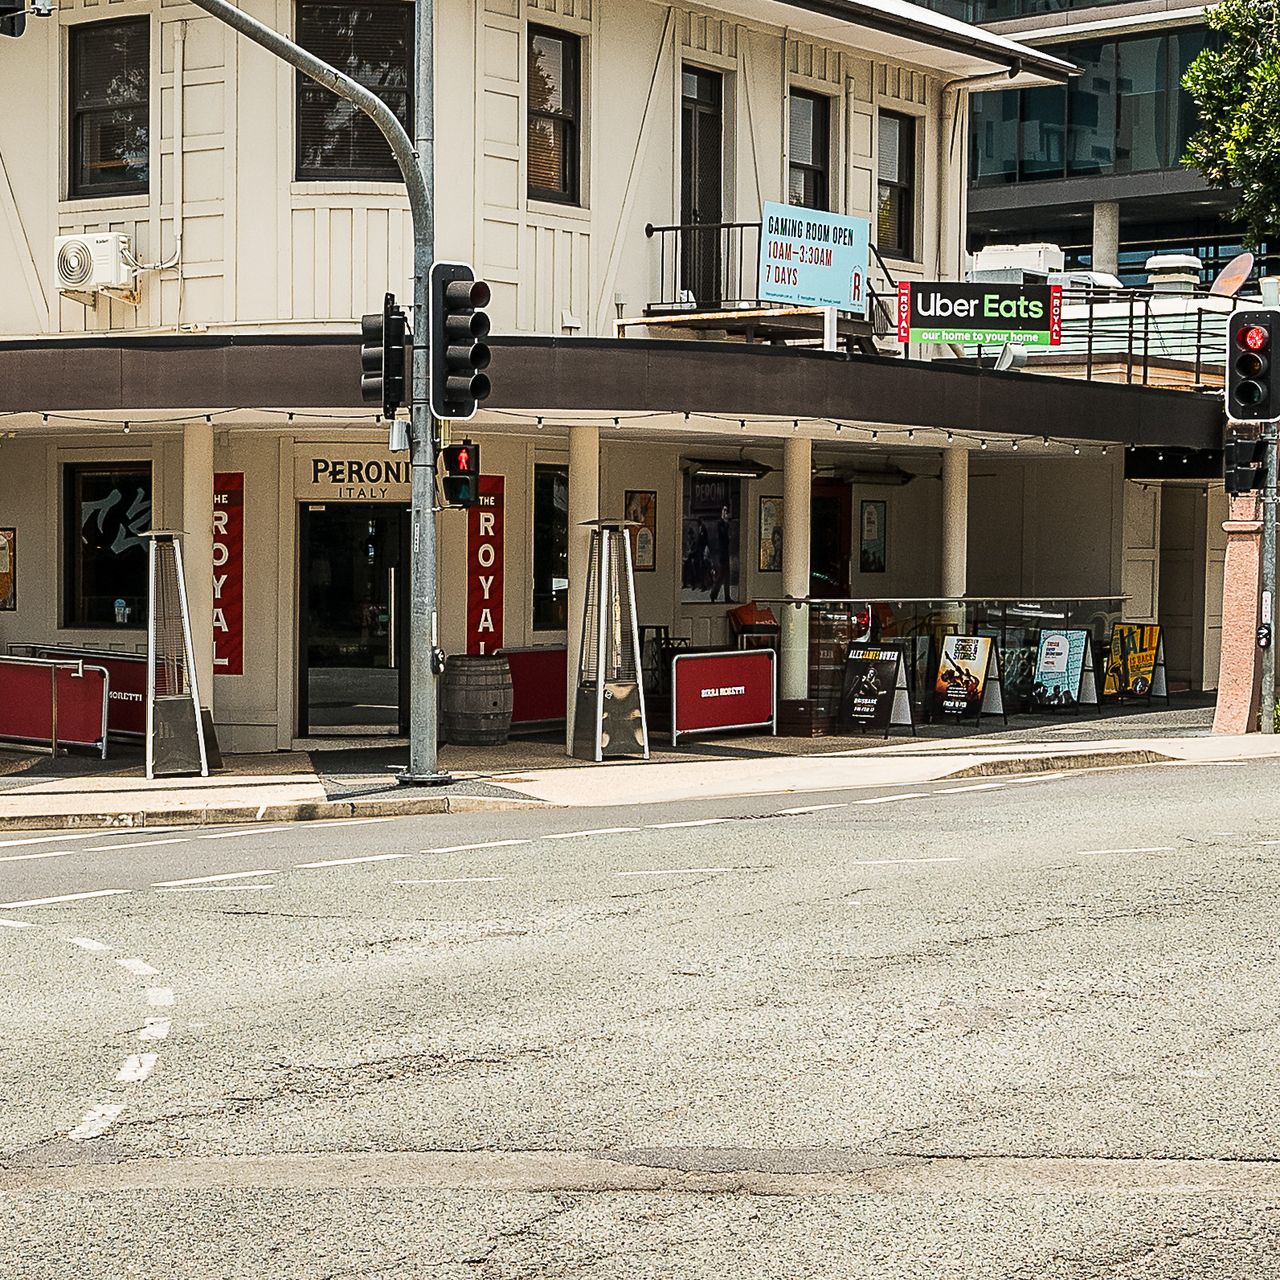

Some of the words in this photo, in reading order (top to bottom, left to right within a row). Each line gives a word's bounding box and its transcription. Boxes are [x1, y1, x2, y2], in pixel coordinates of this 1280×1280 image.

[768, 216, 803, 238] GAMING
[806, 222, 830, 242] ROOM
[832, 226, 854, 246] OPEN
[766, 264, 771, 282] 7
[774, 266, 798, 285] DAYS
[917, 292, 979, 317] Uber
[984, 294, 1044, 318] Eats
[900, 295, 908, 337] ROYAL
[942, 331, 970, 341] home
[972, 333, 983, 341] to
[985, 334, 1009, 343] your
[1011, 332, 1039, 342] home
[312, 459, 412, 484] PERONI
[213, 494, 228, 503] HE
[339, 487, 388, 499] ITALY
[479, 496, 495, 505] THE
